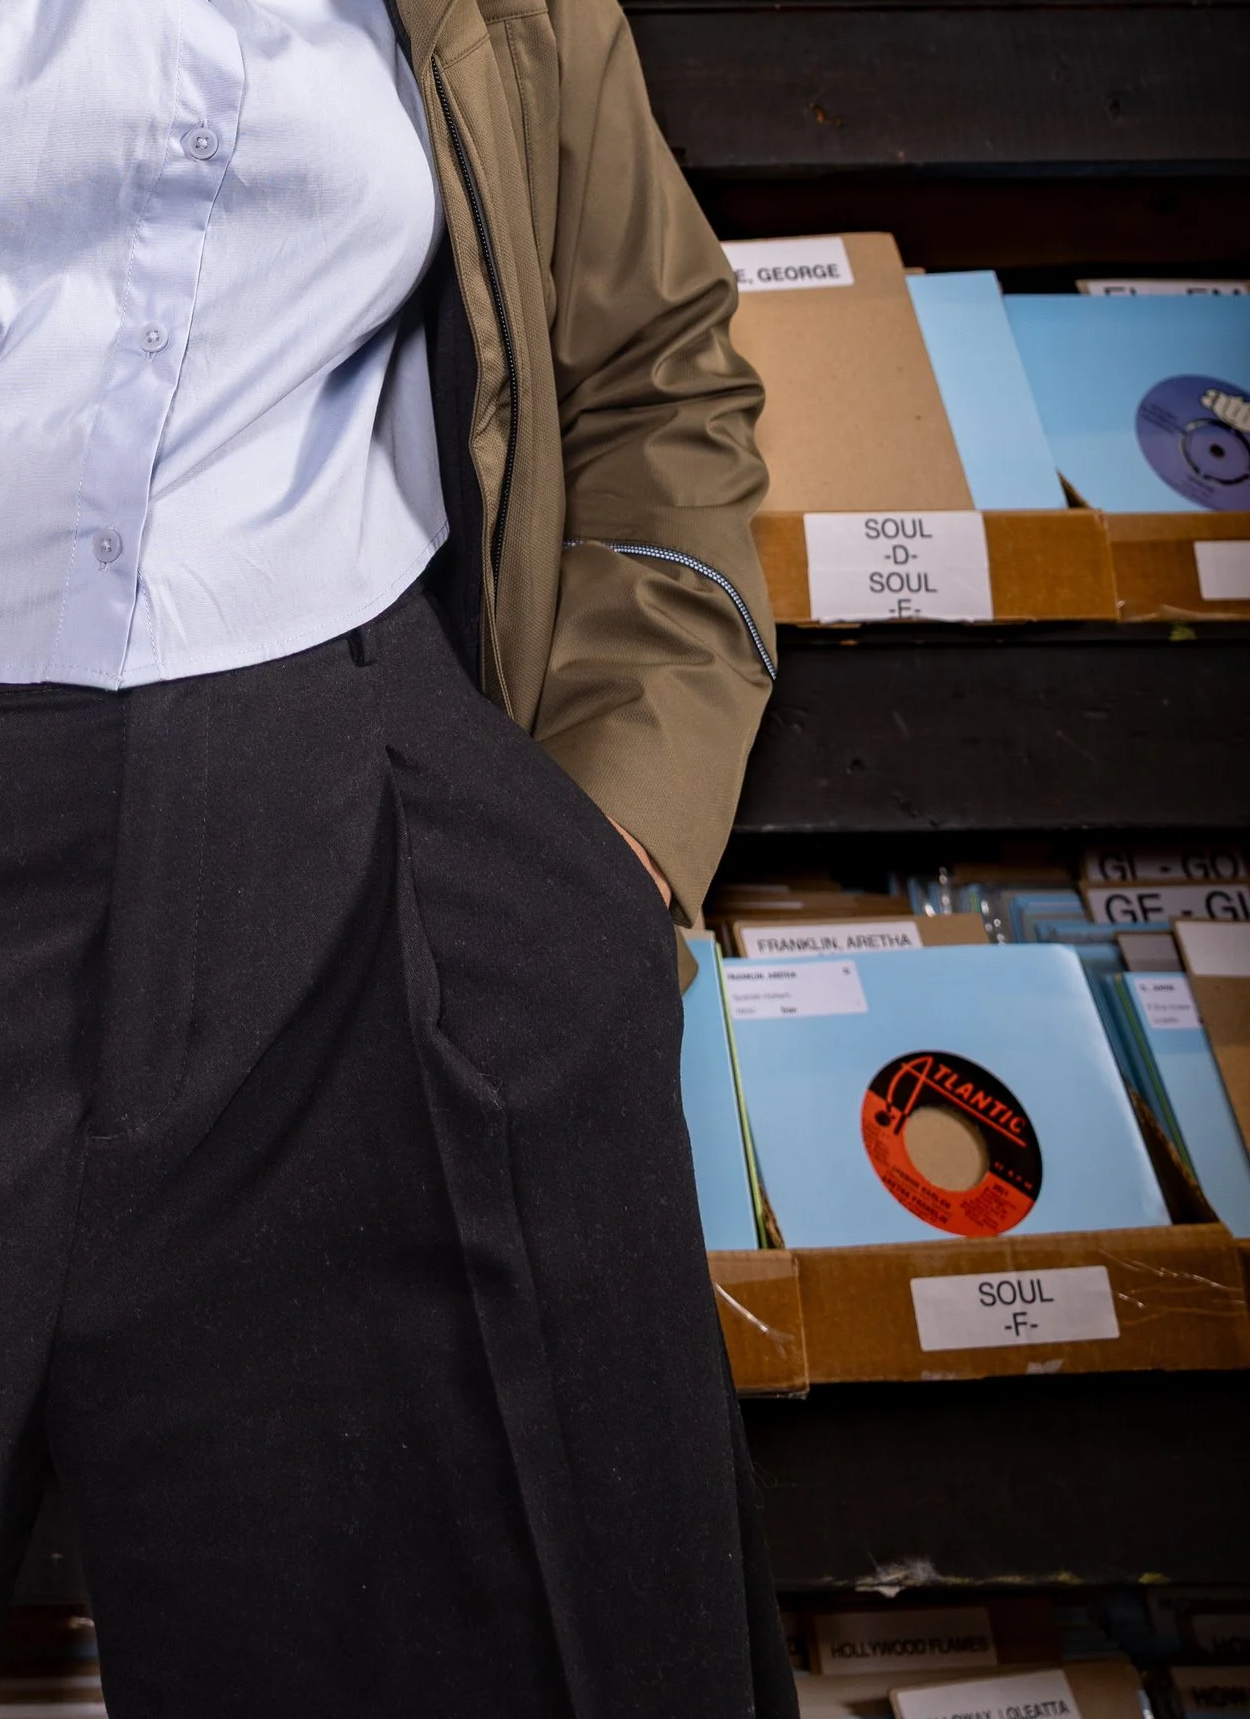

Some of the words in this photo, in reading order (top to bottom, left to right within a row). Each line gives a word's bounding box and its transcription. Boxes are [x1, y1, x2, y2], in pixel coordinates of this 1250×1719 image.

[756, 262, 841, 283] GEORGE
[863, 517, 934, 541] SOUL
[882, 543, 920, 567] -D-
[868, 572, 938, 595] SOUL
[756, 936, 841, 954] FRANKLIN,
[845, 933, 913, 951] ARETHA
[875, 1055, 1028, 1147] ATLANTIC
[977, 1279, 1055, 1308] SOUL
[1003, 1311, 1040, 1338] -F-
[831, 1639, 927, 1660] HOLLYWOOD
[928, 1635, 990, 1655] FLAMES
